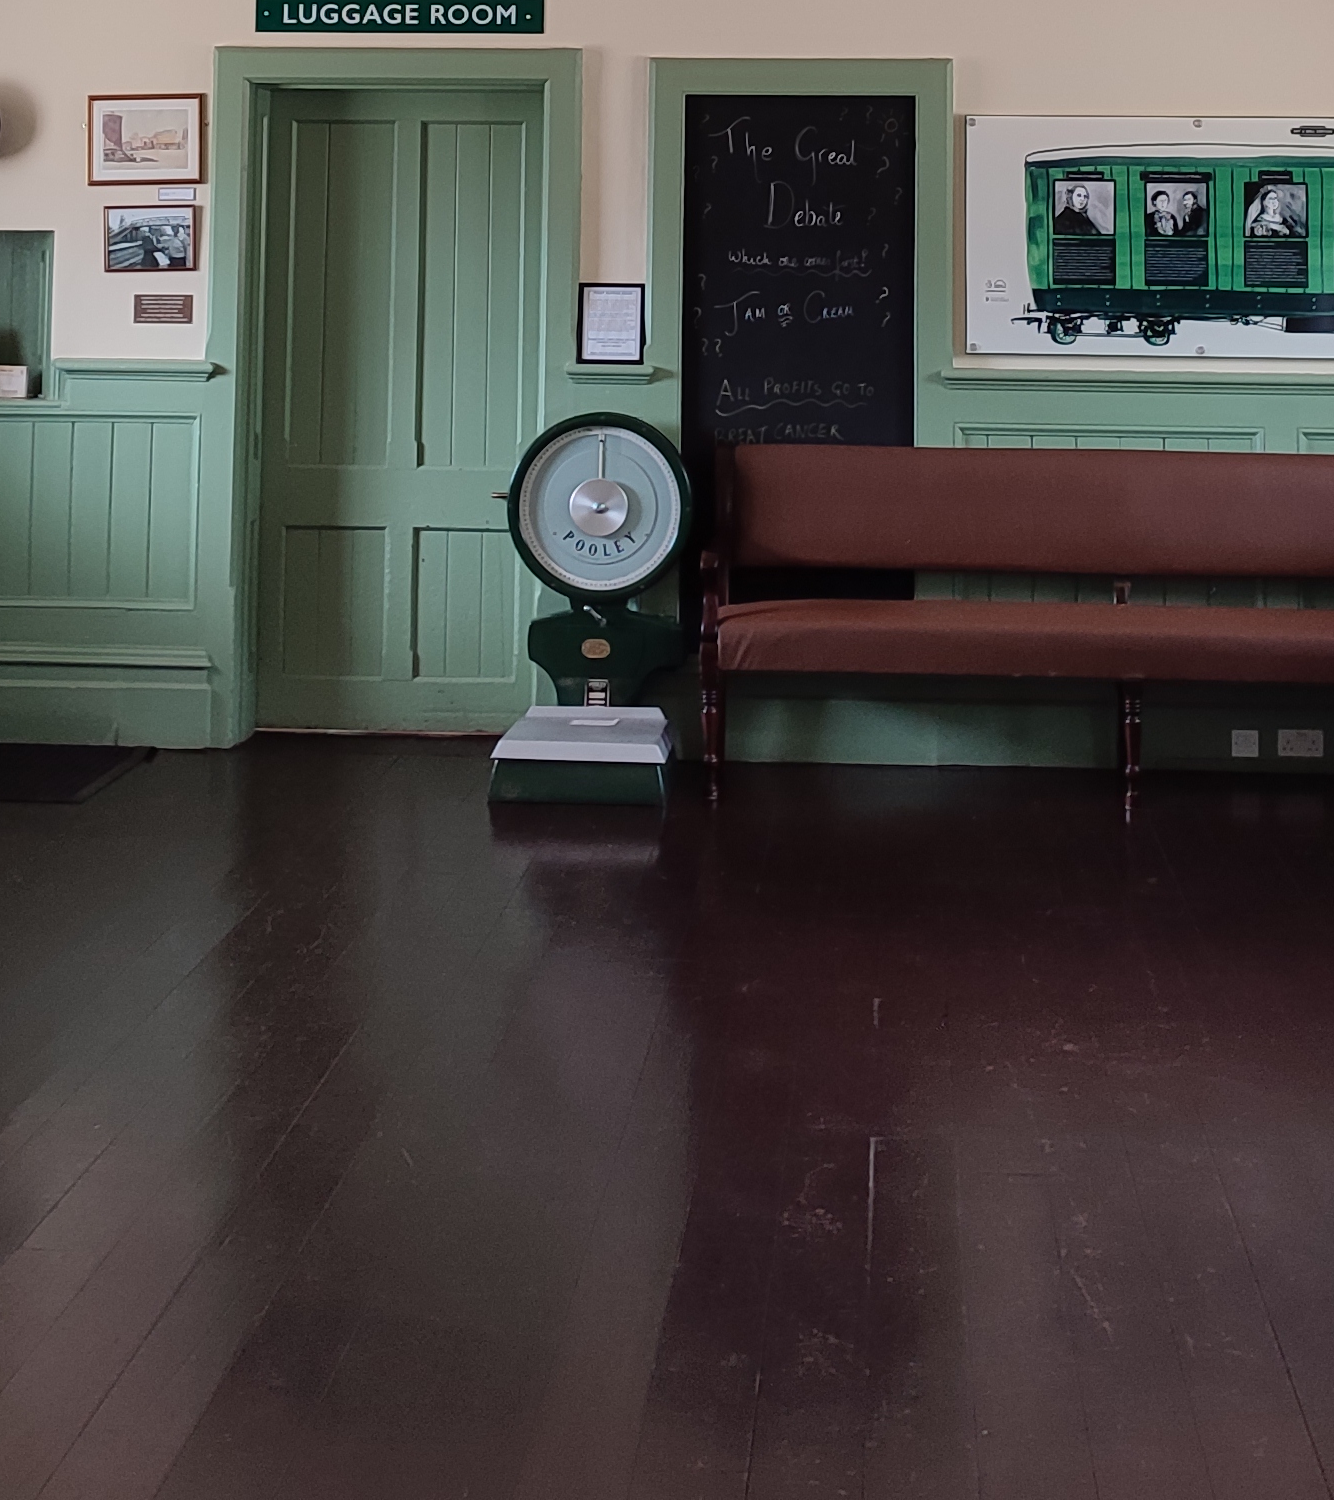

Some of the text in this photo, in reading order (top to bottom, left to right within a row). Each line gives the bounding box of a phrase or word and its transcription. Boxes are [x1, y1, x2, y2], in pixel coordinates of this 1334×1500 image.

[282, 3, 516, 25] LUGGAGE ROOM
[708, 115, 857, 186] The Great
[764, 180, 845, 229] Debate
[728, 248, 771, 266] Which
[774, 422, 844, 441] CANCER
[562, 530, 636, 557] POOLEY
